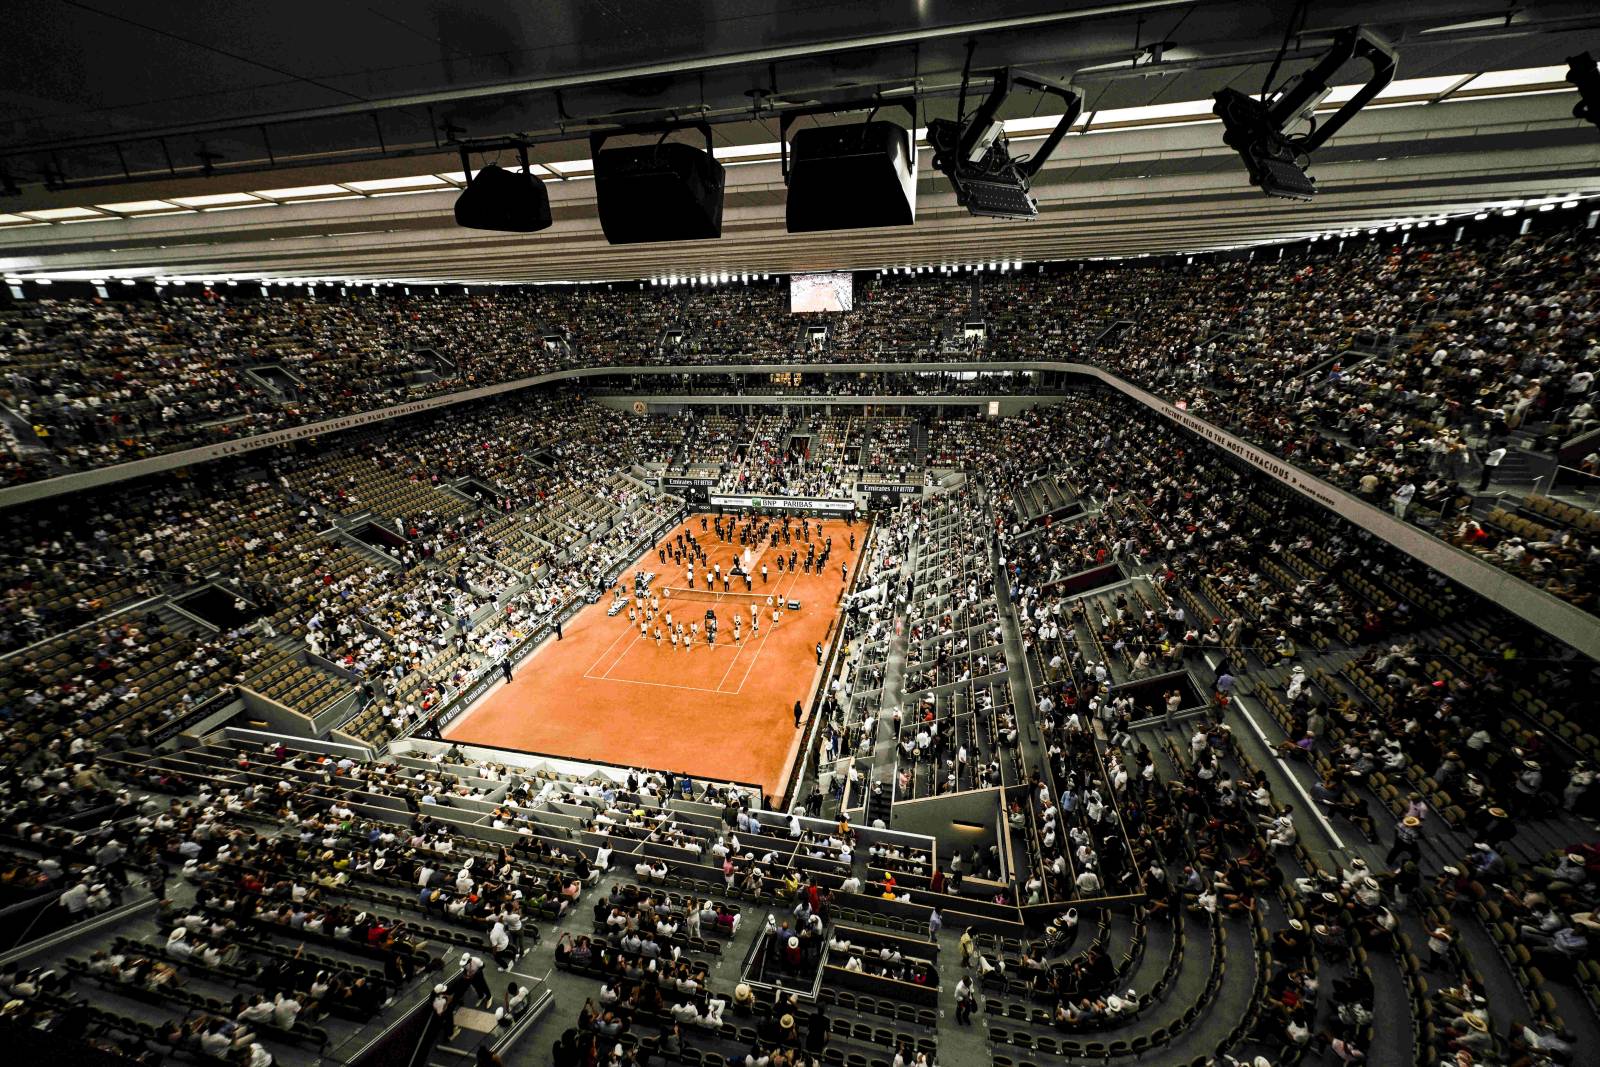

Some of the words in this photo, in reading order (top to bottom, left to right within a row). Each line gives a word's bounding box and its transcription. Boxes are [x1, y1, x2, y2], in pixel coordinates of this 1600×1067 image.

[222, 446, 238, 454] LA
[241, 433, 292, 449] VICTOIRE
[296, 420, 351, 437] APPARTIENT
[354, 417, 365, 425] AU
[367, 412, 386, 422] PLUS
[1165, 406, 1183, 421] VICTORY
[1183, 417, 1205, 433] BELONGS
[1206, 428, 1213, 438] TO
[1214, 433, 1225, 445] THE
[1226, 440, 1244, 455] MOST
[1246, 450, 1290, 480] TENACIOUS
[863, 484, 891, 492] Emirates
[783, 500, 813, 508] PARIBAS
[534, 626, 551, 643] oppo
[514, 642, 533, 660] oppo
[463, 683, 488, 705] Emirates
